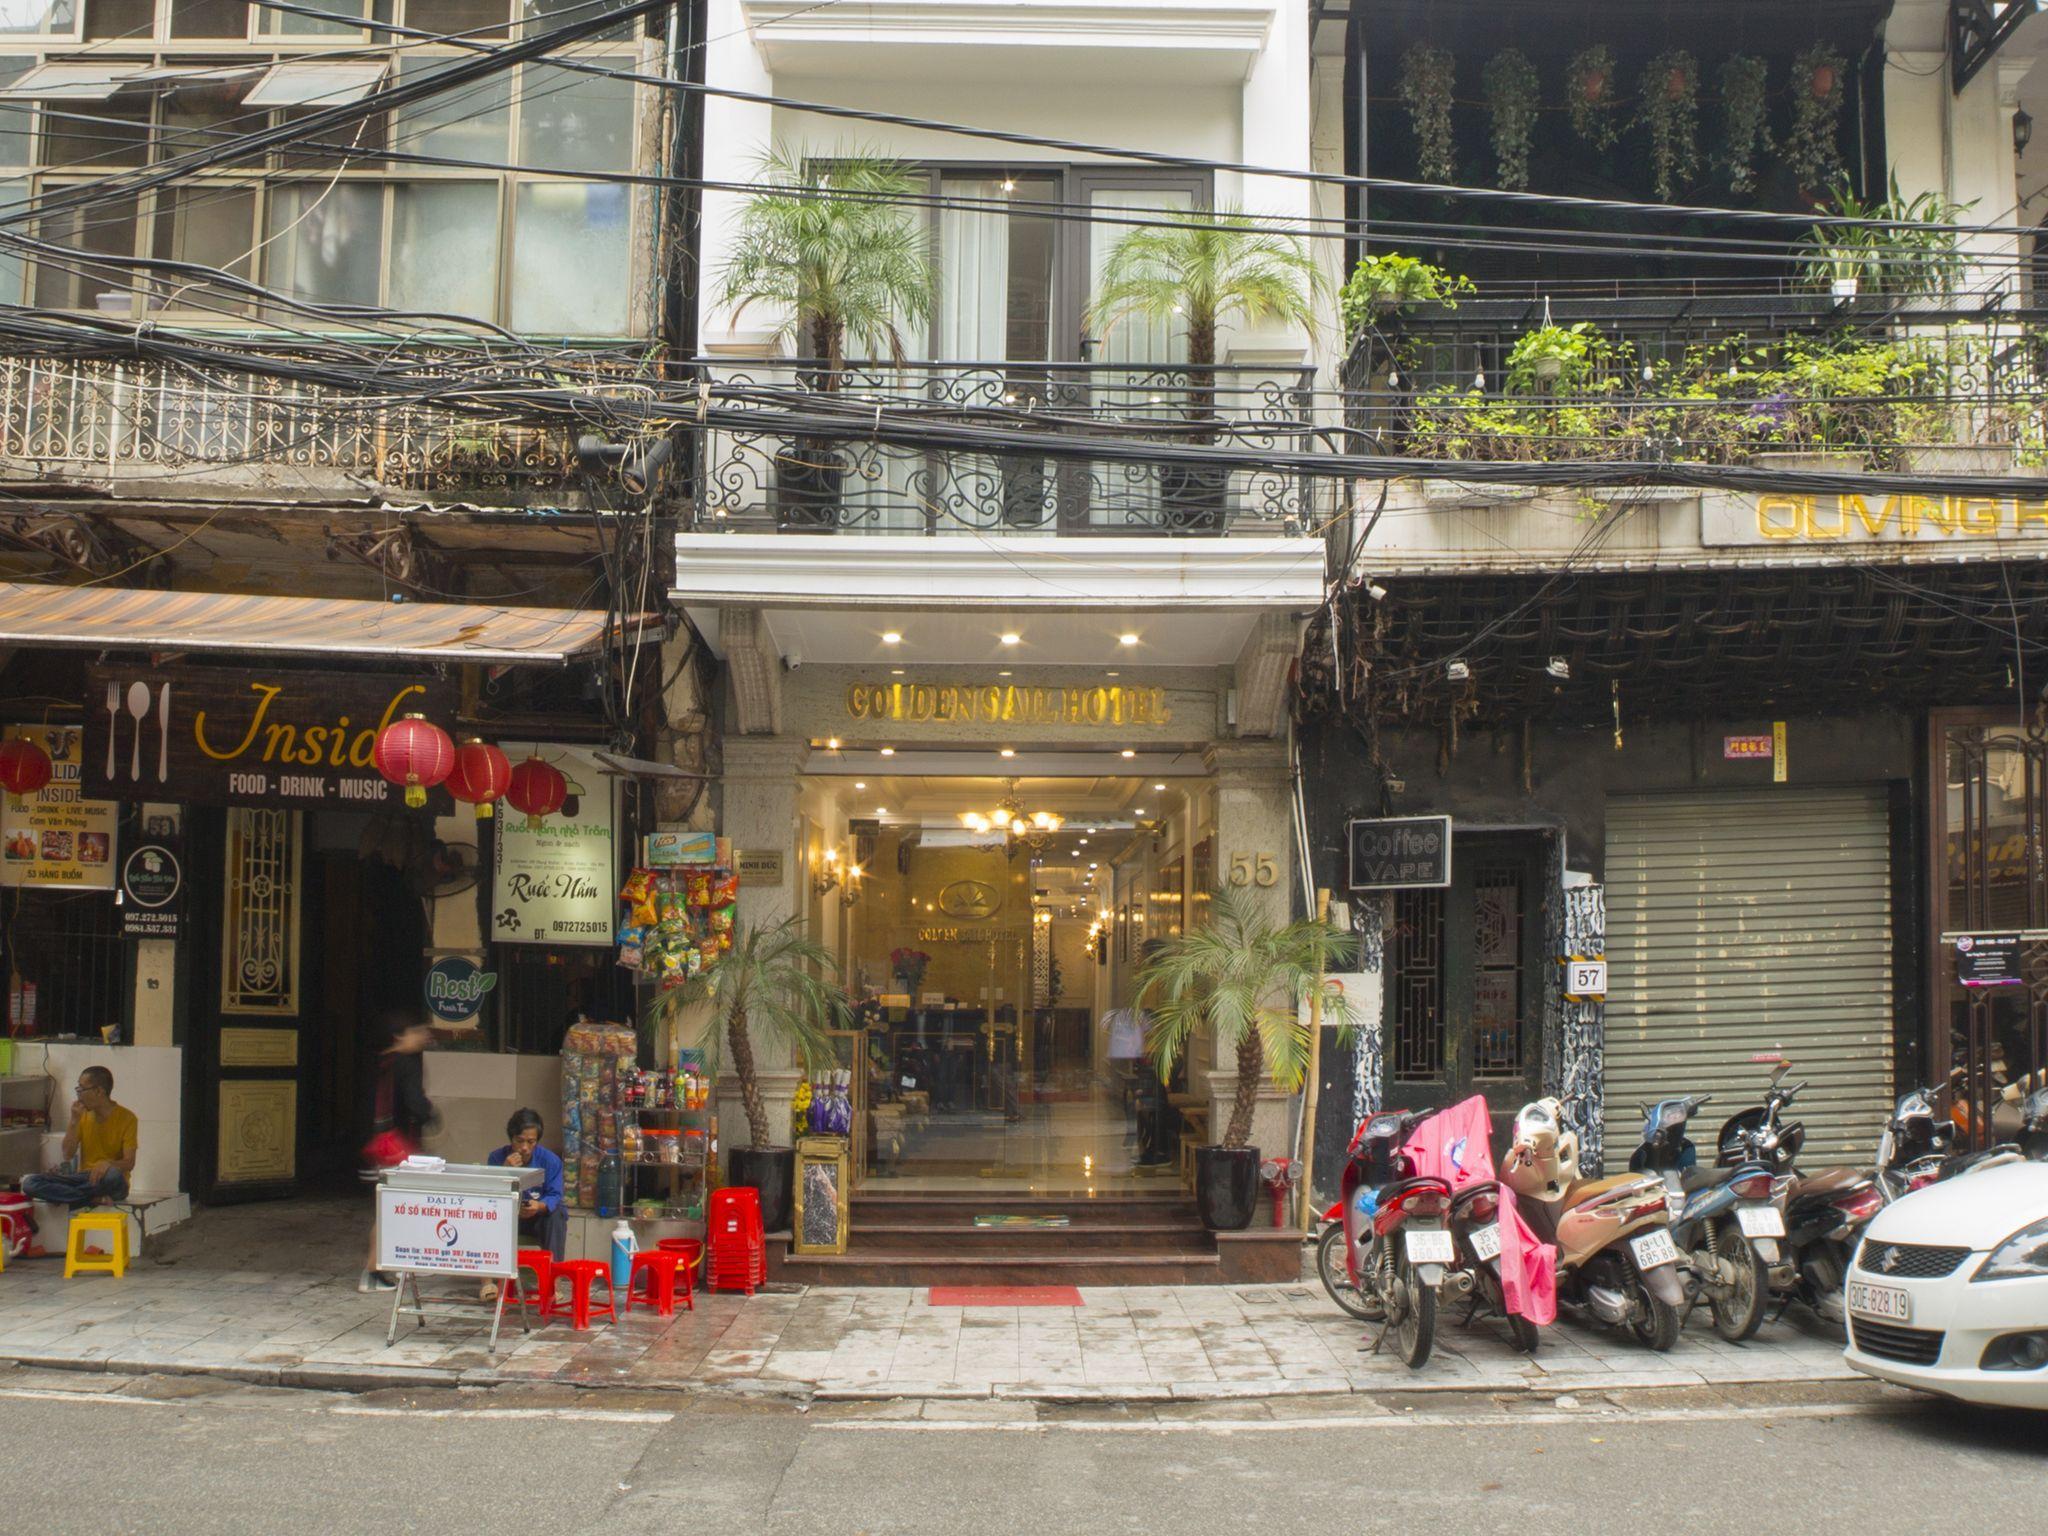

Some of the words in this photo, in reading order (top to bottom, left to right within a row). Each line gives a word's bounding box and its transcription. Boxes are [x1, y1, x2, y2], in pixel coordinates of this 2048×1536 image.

[847, 683, 977, 720] GOLDEN
[981, 684, 1057, 722] SAIL
[1061, 686, 1170, 725] HOTEL
[194, 682, 427, 769] Insid
[229, 773, 267, 794] FOOD
[280, 776, 325, 798] DRINK
[339, 777, 388, 800] MUSIC
[1359, 830, 1439, 857] Coffee
[1229, 851, 1280, 887] 55
[1366, 861, 1434, 880] VAPE
[552, 920, 608, 933] 0972725015
[430, 971, 481, 1001] Rest
[1577, 969, 1600, 987] 57
